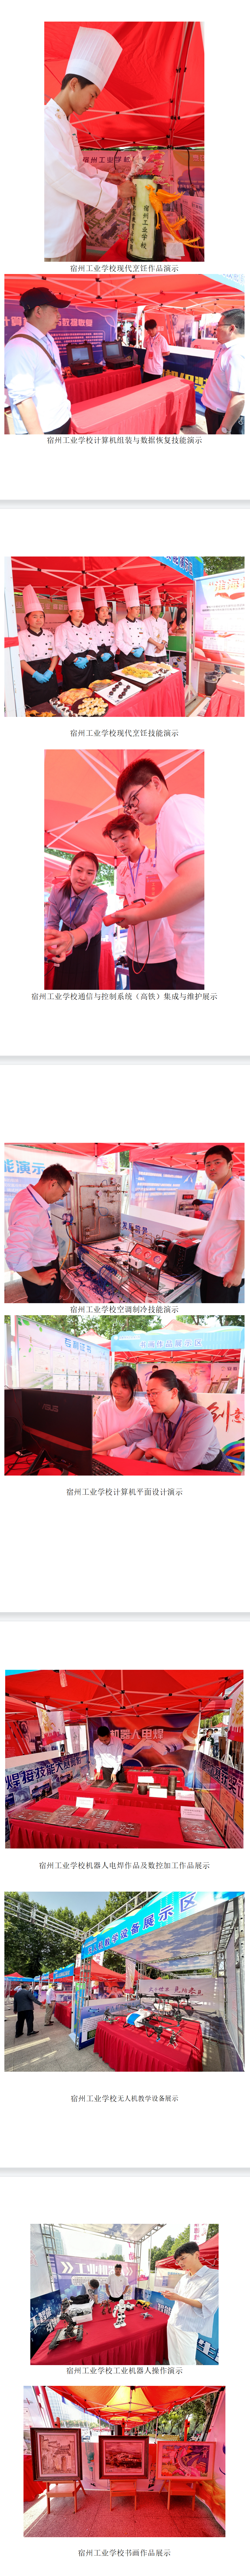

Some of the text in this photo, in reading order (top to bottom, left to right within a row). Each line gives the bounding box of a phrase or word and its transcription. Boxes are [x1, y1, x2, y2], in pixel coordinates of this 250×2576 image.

[140, 205, 149, 249] 宿州工业学校
[4, 1159, 45, 1175] 能演示
[64, 1338, 91, 1353] 专利证书
[139, 1338, 202, 1349] 书画作品展示区
[37, 1374, 52, 1382] 宿州大道
[42, 1403, 58, 1412] ASUS
[110, 1729, 164, 1740] 机器人电焊
[5, 1756, 81, 1790] 焊接技能大赛剪影
[88, 1892, 197, 1954] 无人机教学设备展示区
[75, 2263, 125, 2276] 工业机器人
[30, 2306, 52, 2333] 工智能
